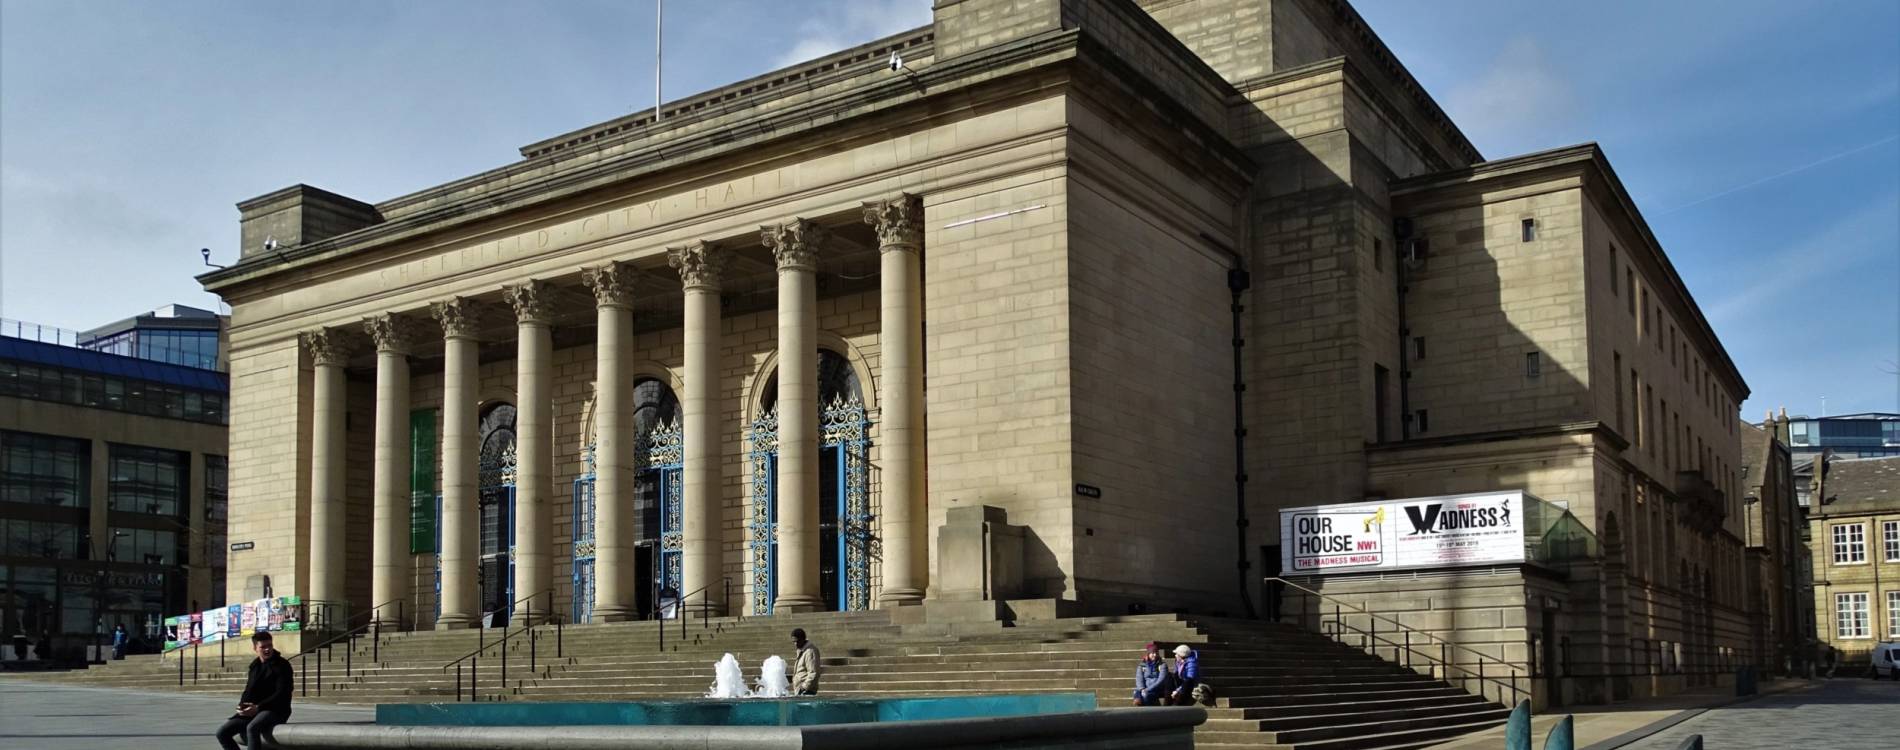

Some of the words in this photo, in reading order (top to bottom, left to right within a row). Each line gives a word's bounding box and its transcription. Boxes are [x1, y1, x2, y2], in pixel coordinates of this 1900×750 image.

[582, 201, 658, 236] CITY
[695, 169, 785, 209] HALL
[1299, 517, 1332, 535] OUR
[1299, 535, 1353, 554] HOUSE
[1357, 541, 1377, 551] NW1
[1298, 559, 1312, 567] THE
[1314, 556, 1348, 566] MADNESS
[1349, 555, 1378, 563] MUSICAL
